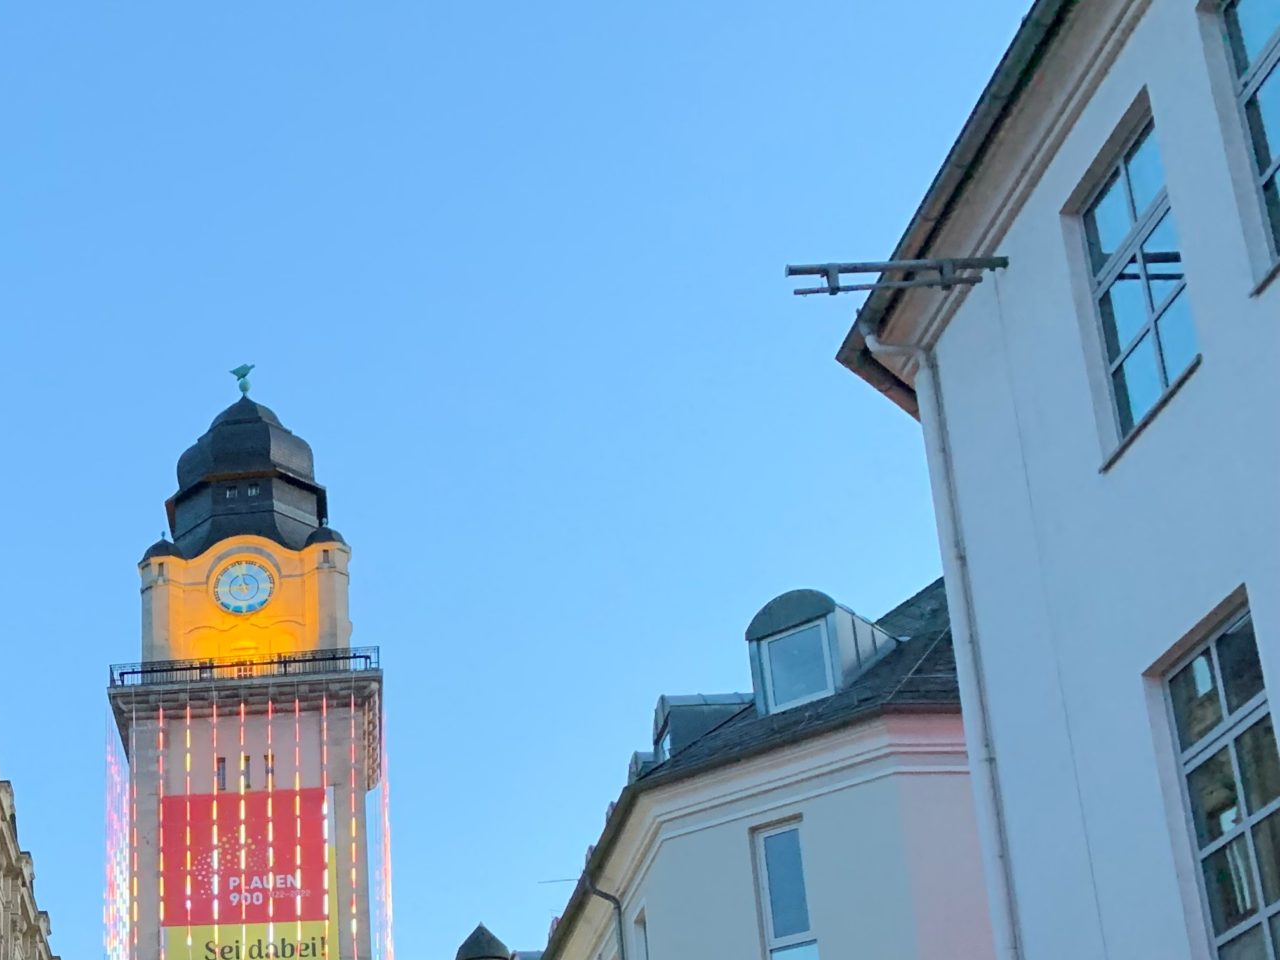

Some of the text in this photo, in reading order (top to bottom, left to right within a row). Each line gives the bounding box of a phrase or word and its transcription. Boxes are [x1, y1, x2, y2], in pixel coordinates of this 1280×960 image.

[229, 892, 263, 906] 900
[204, 936, 326, 960] Sei dabei!
